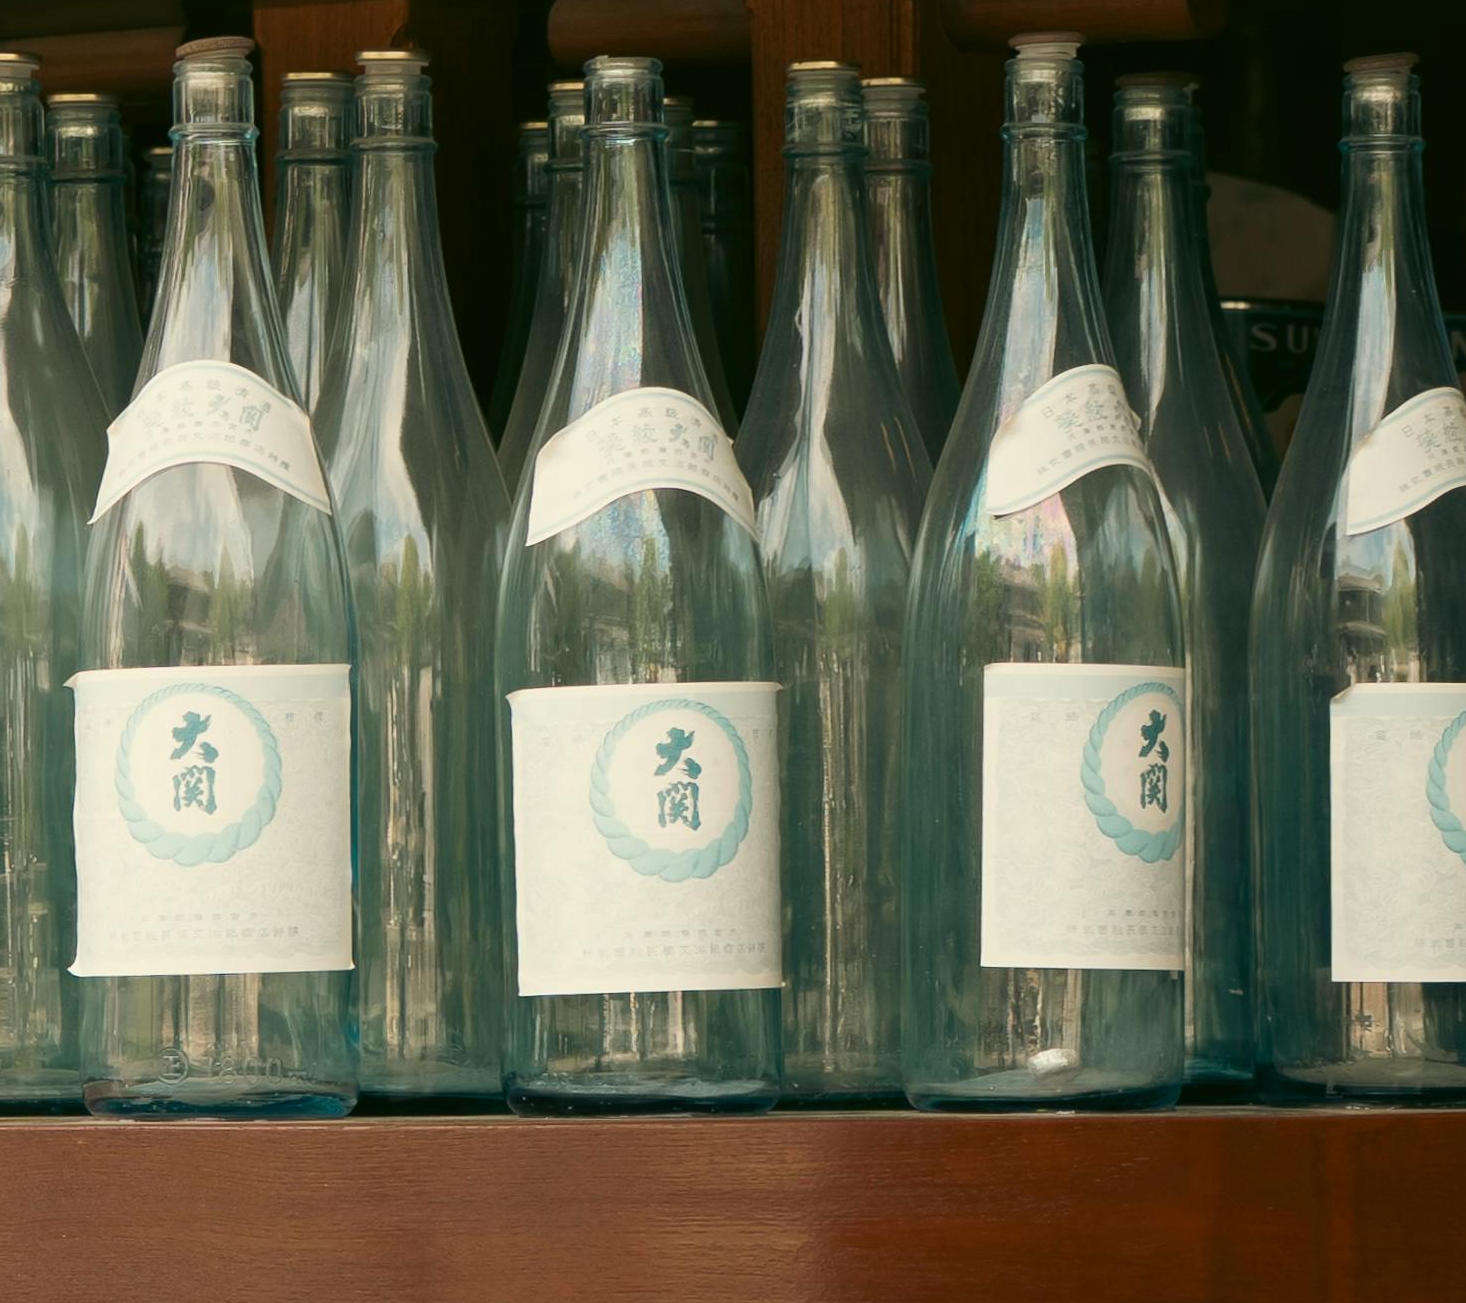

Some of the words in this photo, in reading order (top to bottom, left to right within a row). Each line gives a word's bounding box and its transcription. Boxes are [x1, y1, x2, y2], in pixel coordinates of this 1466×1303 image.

[170, 710, 219, 815] 大関
[654, 727, 703, 832] 大関
[1139, 710, 1171, 814] 大関
